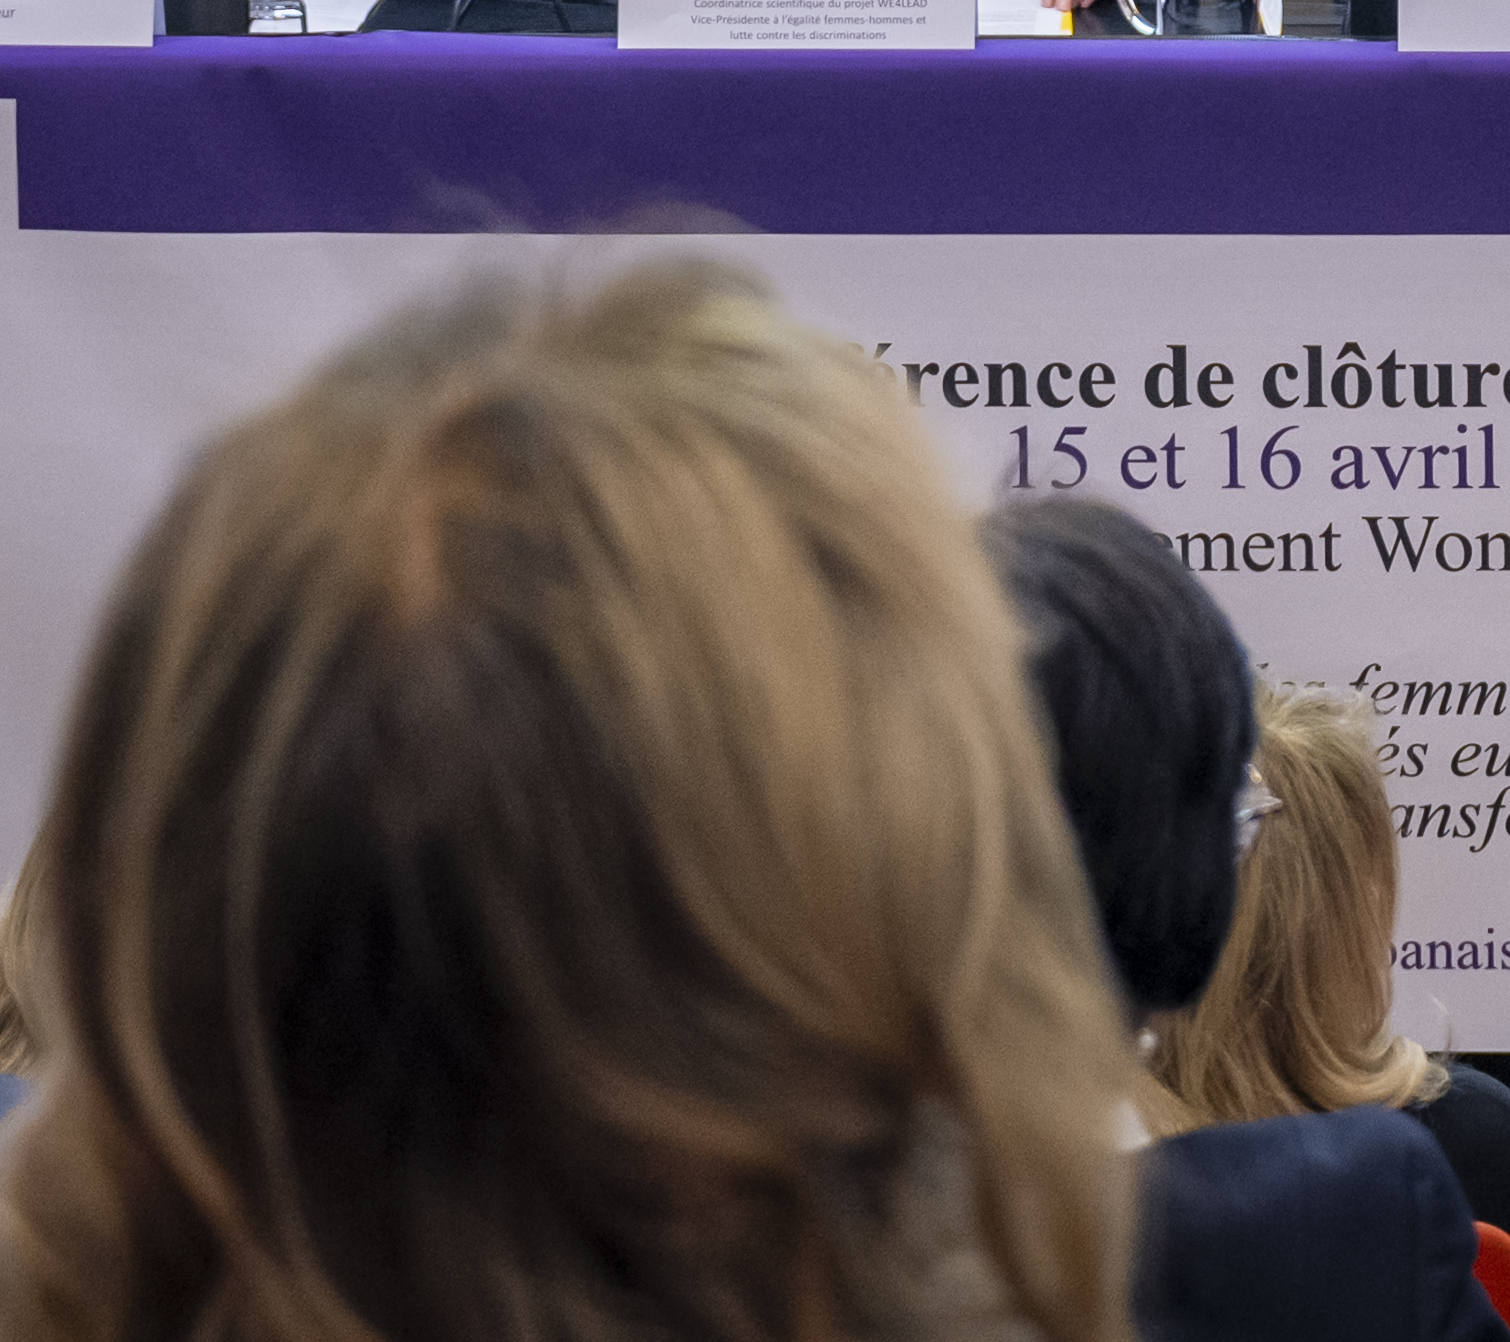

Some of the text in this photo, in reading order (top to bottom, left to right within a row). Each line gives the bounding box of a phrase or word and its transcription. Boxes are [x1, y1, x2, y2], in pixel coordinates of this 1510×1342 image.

[691, 13, 770, 26] Vice-Présidente
[773, 14, 779, 25] à
[824, 15, 914, 26] femmes-hommes
[916, 15, 926, 25] et
[730, 30, 887, 40] lutte contre les discriminations
[1143, 343, 1235, 408] de
[1008, 424, 1089, 490] 15
[1119, 433, 1188, 490] et
[1220, 424, 1302, 490] 16
[1330, 422, 1501, 490] avril
